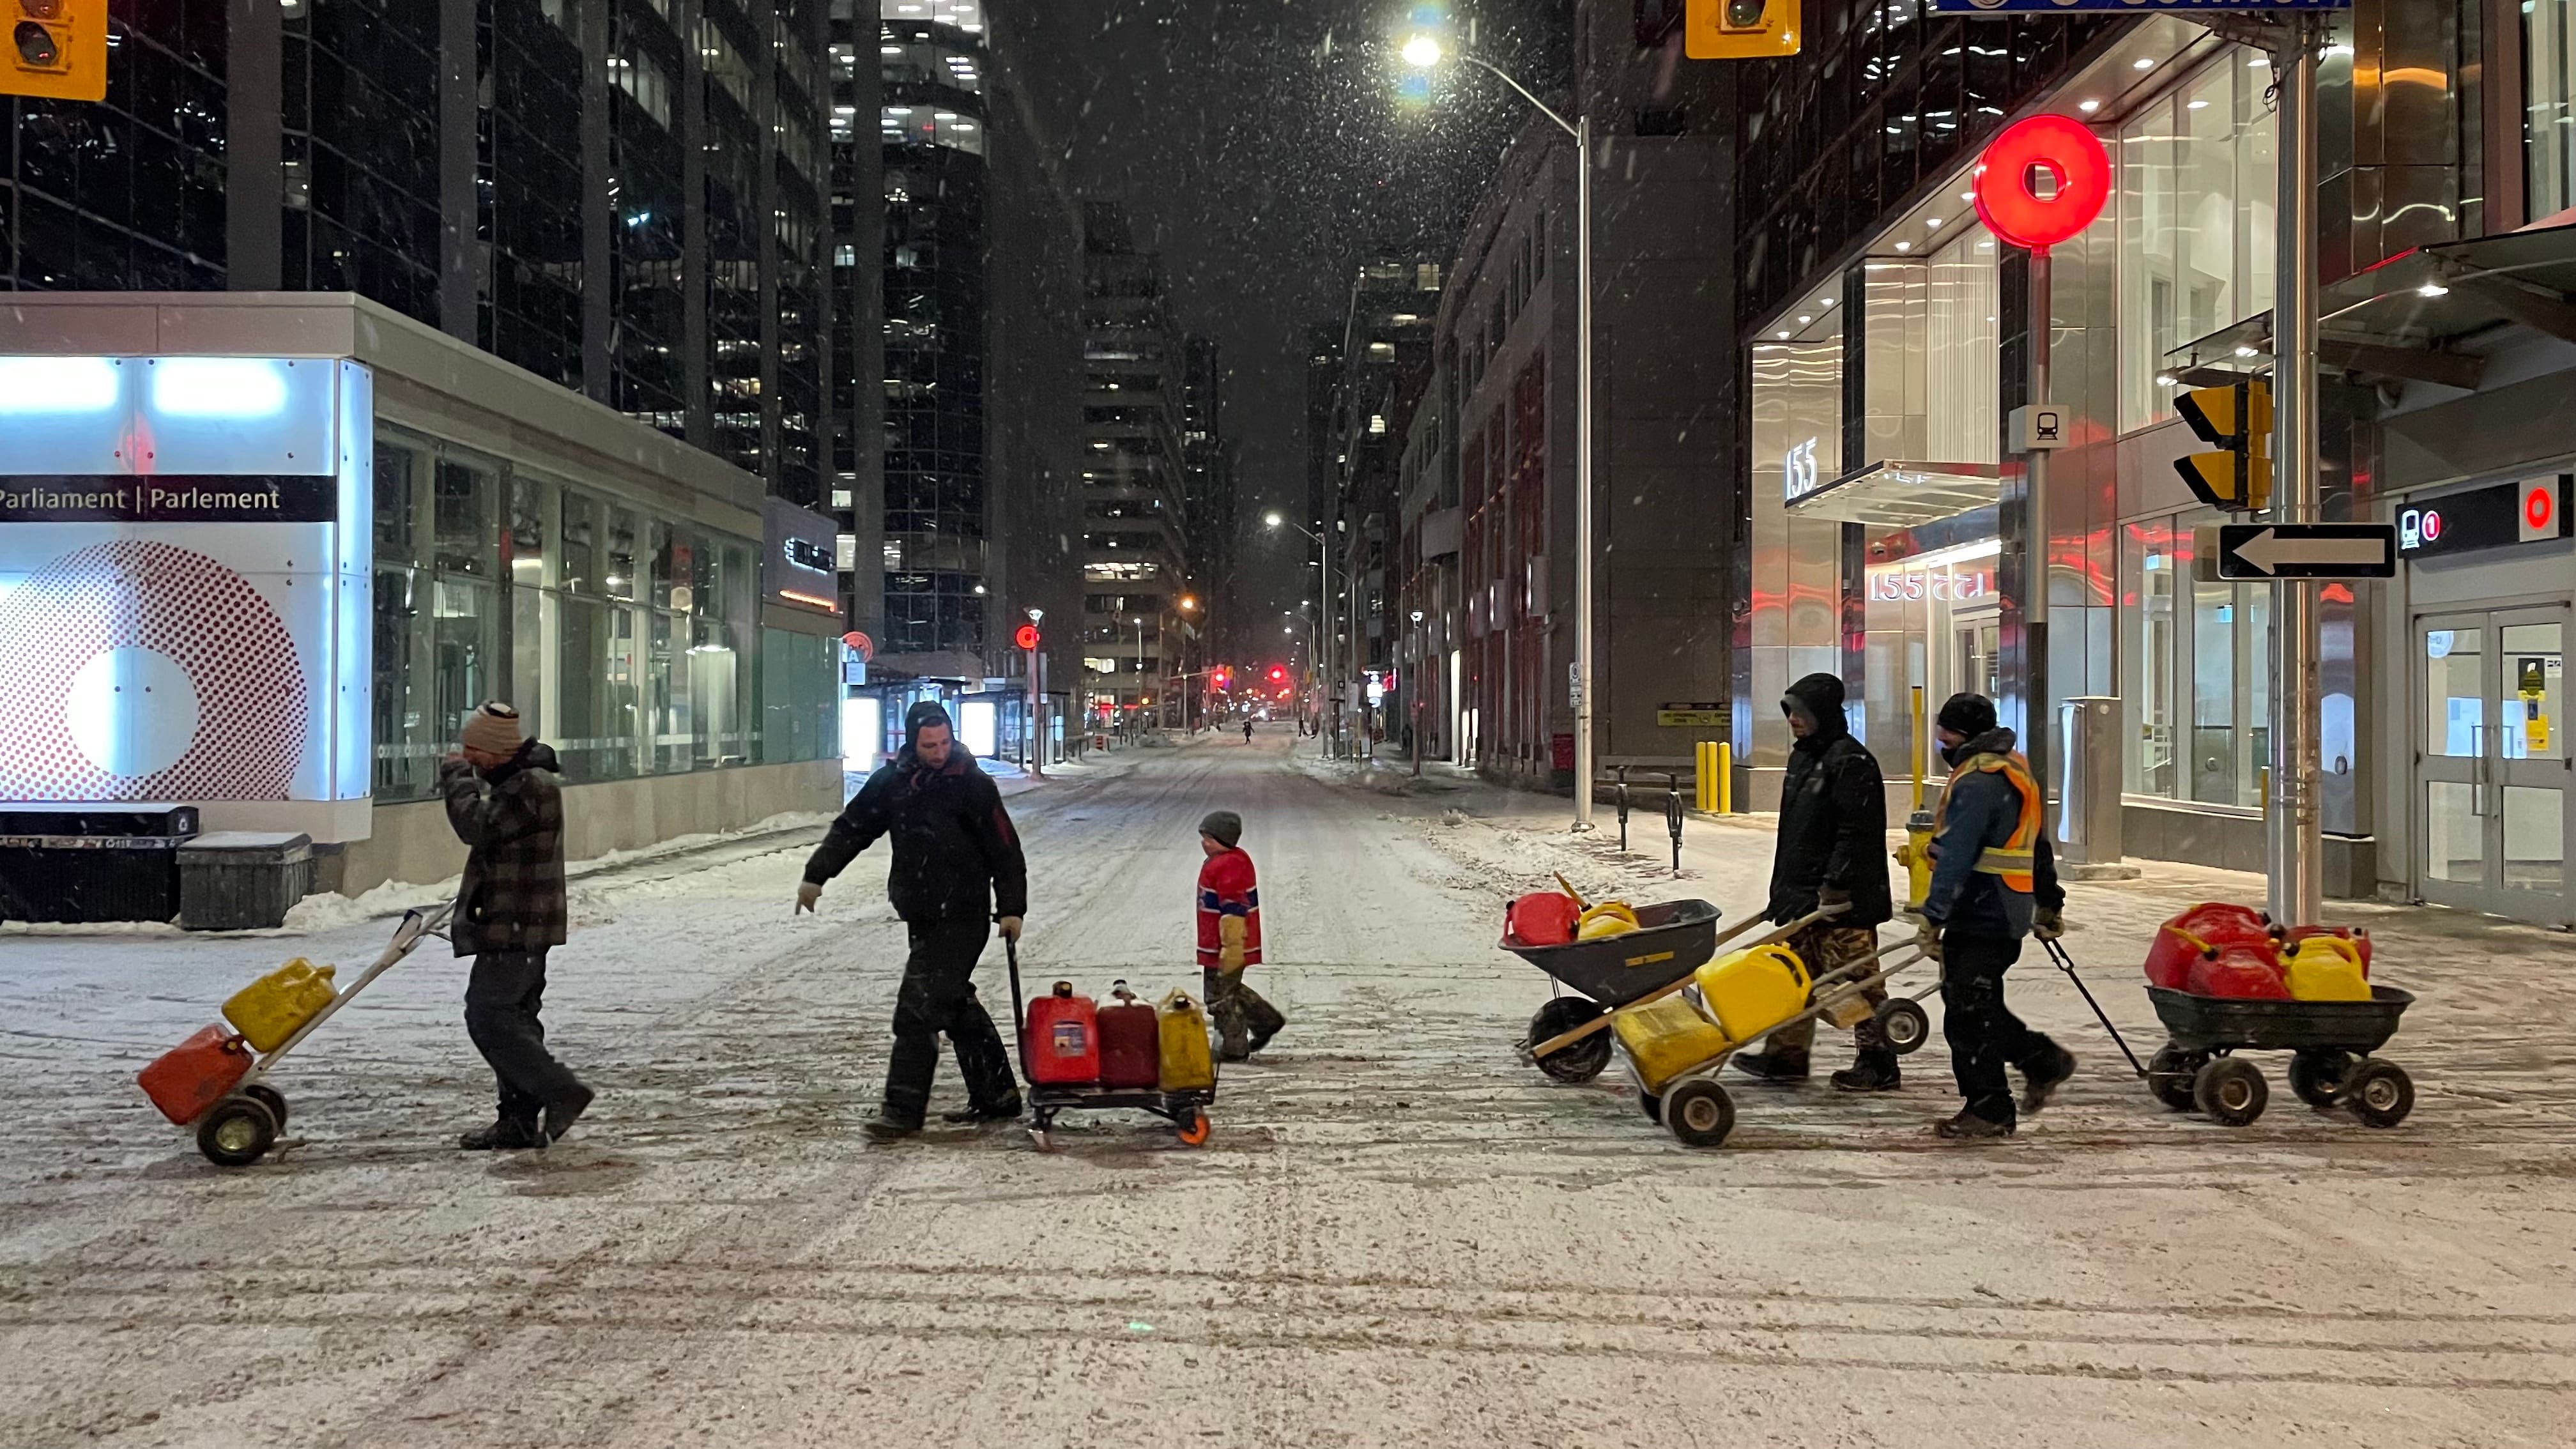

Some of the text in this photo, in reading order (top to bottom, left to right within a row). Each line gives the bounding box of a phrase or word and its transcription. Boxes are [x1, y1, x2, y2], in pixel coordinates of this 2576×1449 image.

[1786, 436, 1818, 500] 155
[151, 487, 280, 509] Parlement
[1871, 573, 1924, 601] 155
